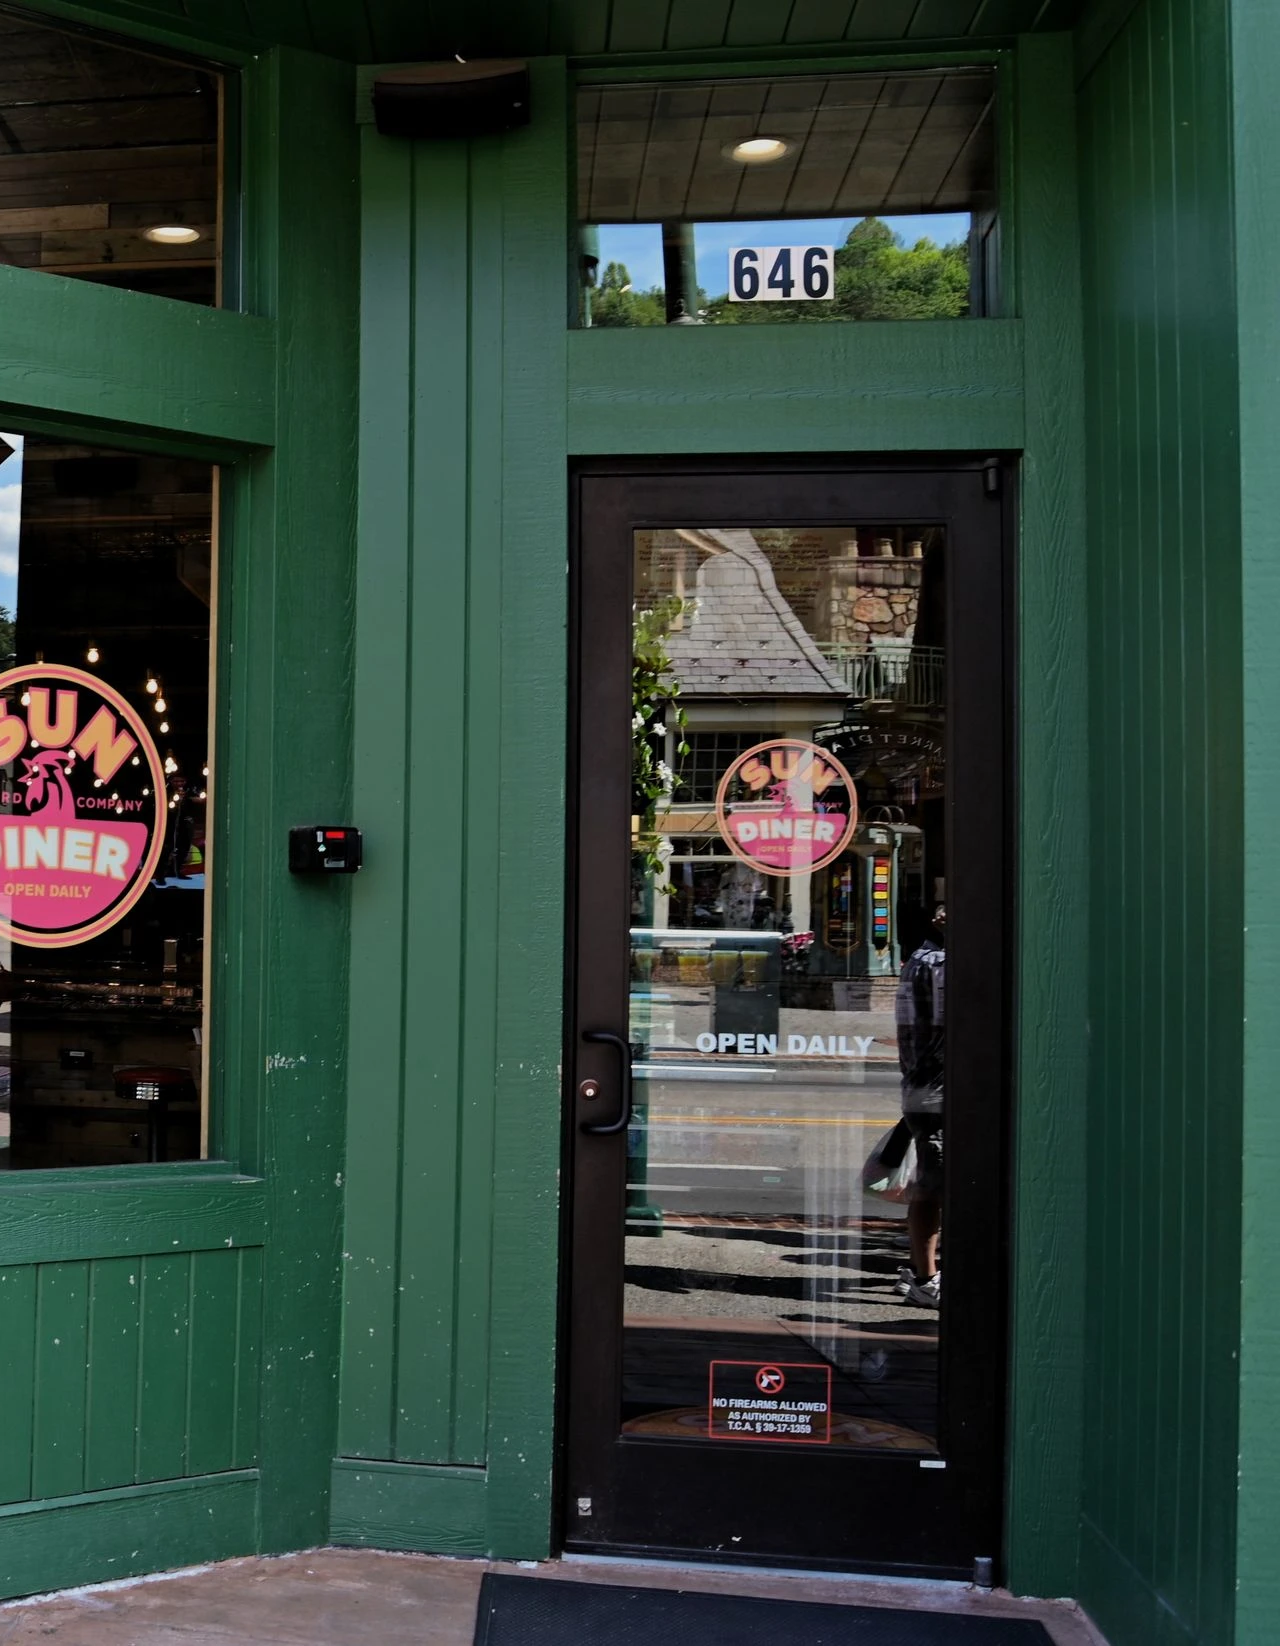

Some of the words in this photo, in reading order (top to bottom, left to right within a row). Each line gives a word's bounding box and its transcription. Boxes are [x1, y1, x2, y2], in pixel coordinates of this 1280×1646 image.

[733, 247, 829, 300] 646
[739, 750, 839, 795] SUN
[76, 796, 143, 812] COMPANY
[736, 818, 836, 844] DINER
[4, 881, 45, 897] OPEN
[49, 883, 92, 898] DAILY
[695, 1032, 778, 1055] OPEN
[787, 1034, 873, 1057] DAILY
[712, 1398, 727, 1407] NO
[728, 1399, 778, 1410] FIREARMS
[779, 1401, 827, 1412] ALLOWED
[728, 1411, 741, 1420] AS
[741, 1412, 797, 1423] AUTHORIZED
[798, 1414, 811, 1423] BY
[728, 1421, 753, 1431] T.C.A.
